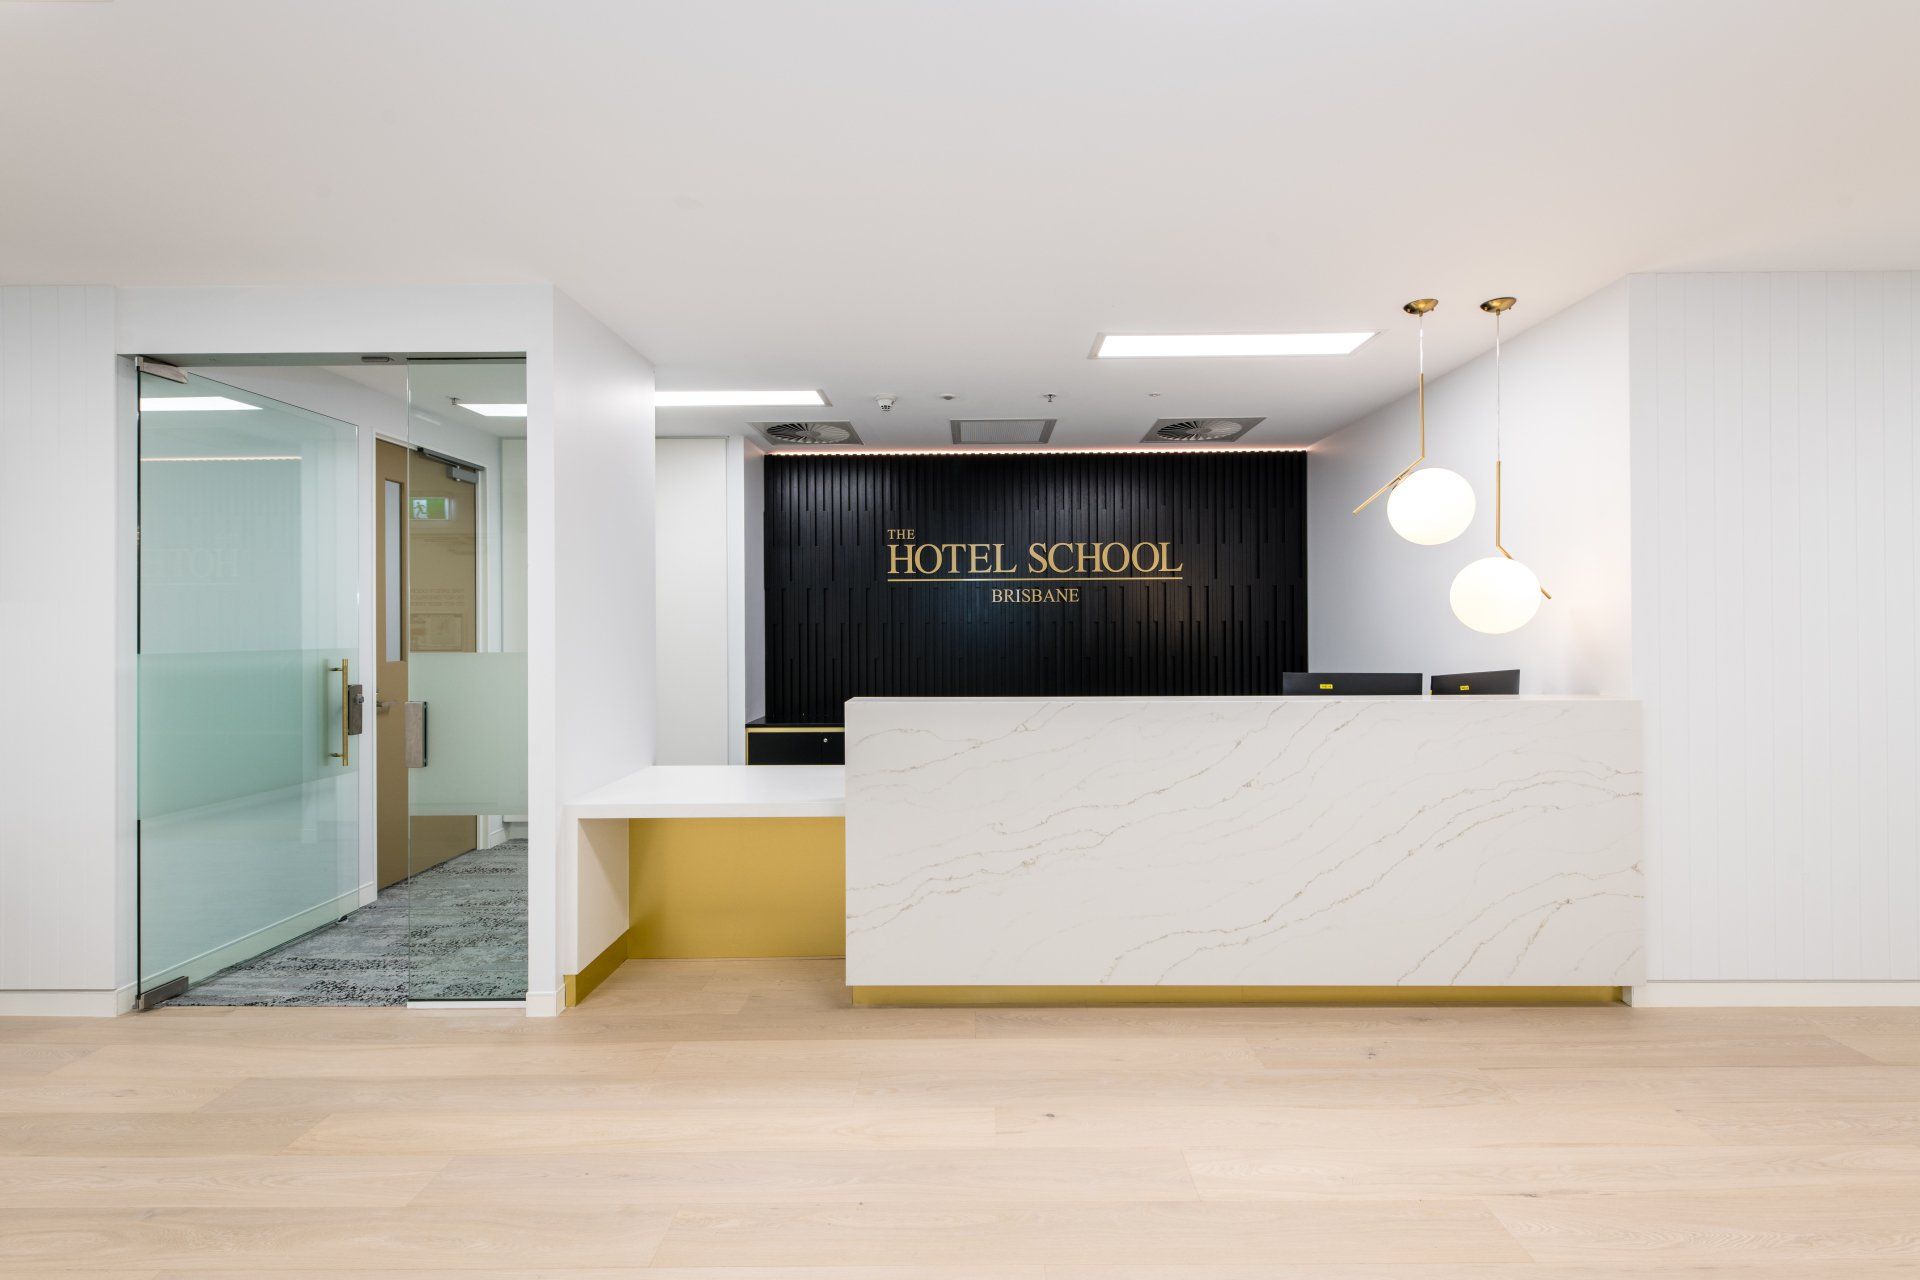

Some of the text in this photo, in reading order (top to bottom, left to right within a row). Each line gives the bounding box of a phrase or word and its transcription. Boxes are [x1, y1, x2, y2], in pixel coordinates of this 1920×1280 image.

[887, 529, 915, 540] THE
[887, 542, 1183, 574] HOTEL SCHOOL
[991, 588, 1080, 603] BRISBANE
